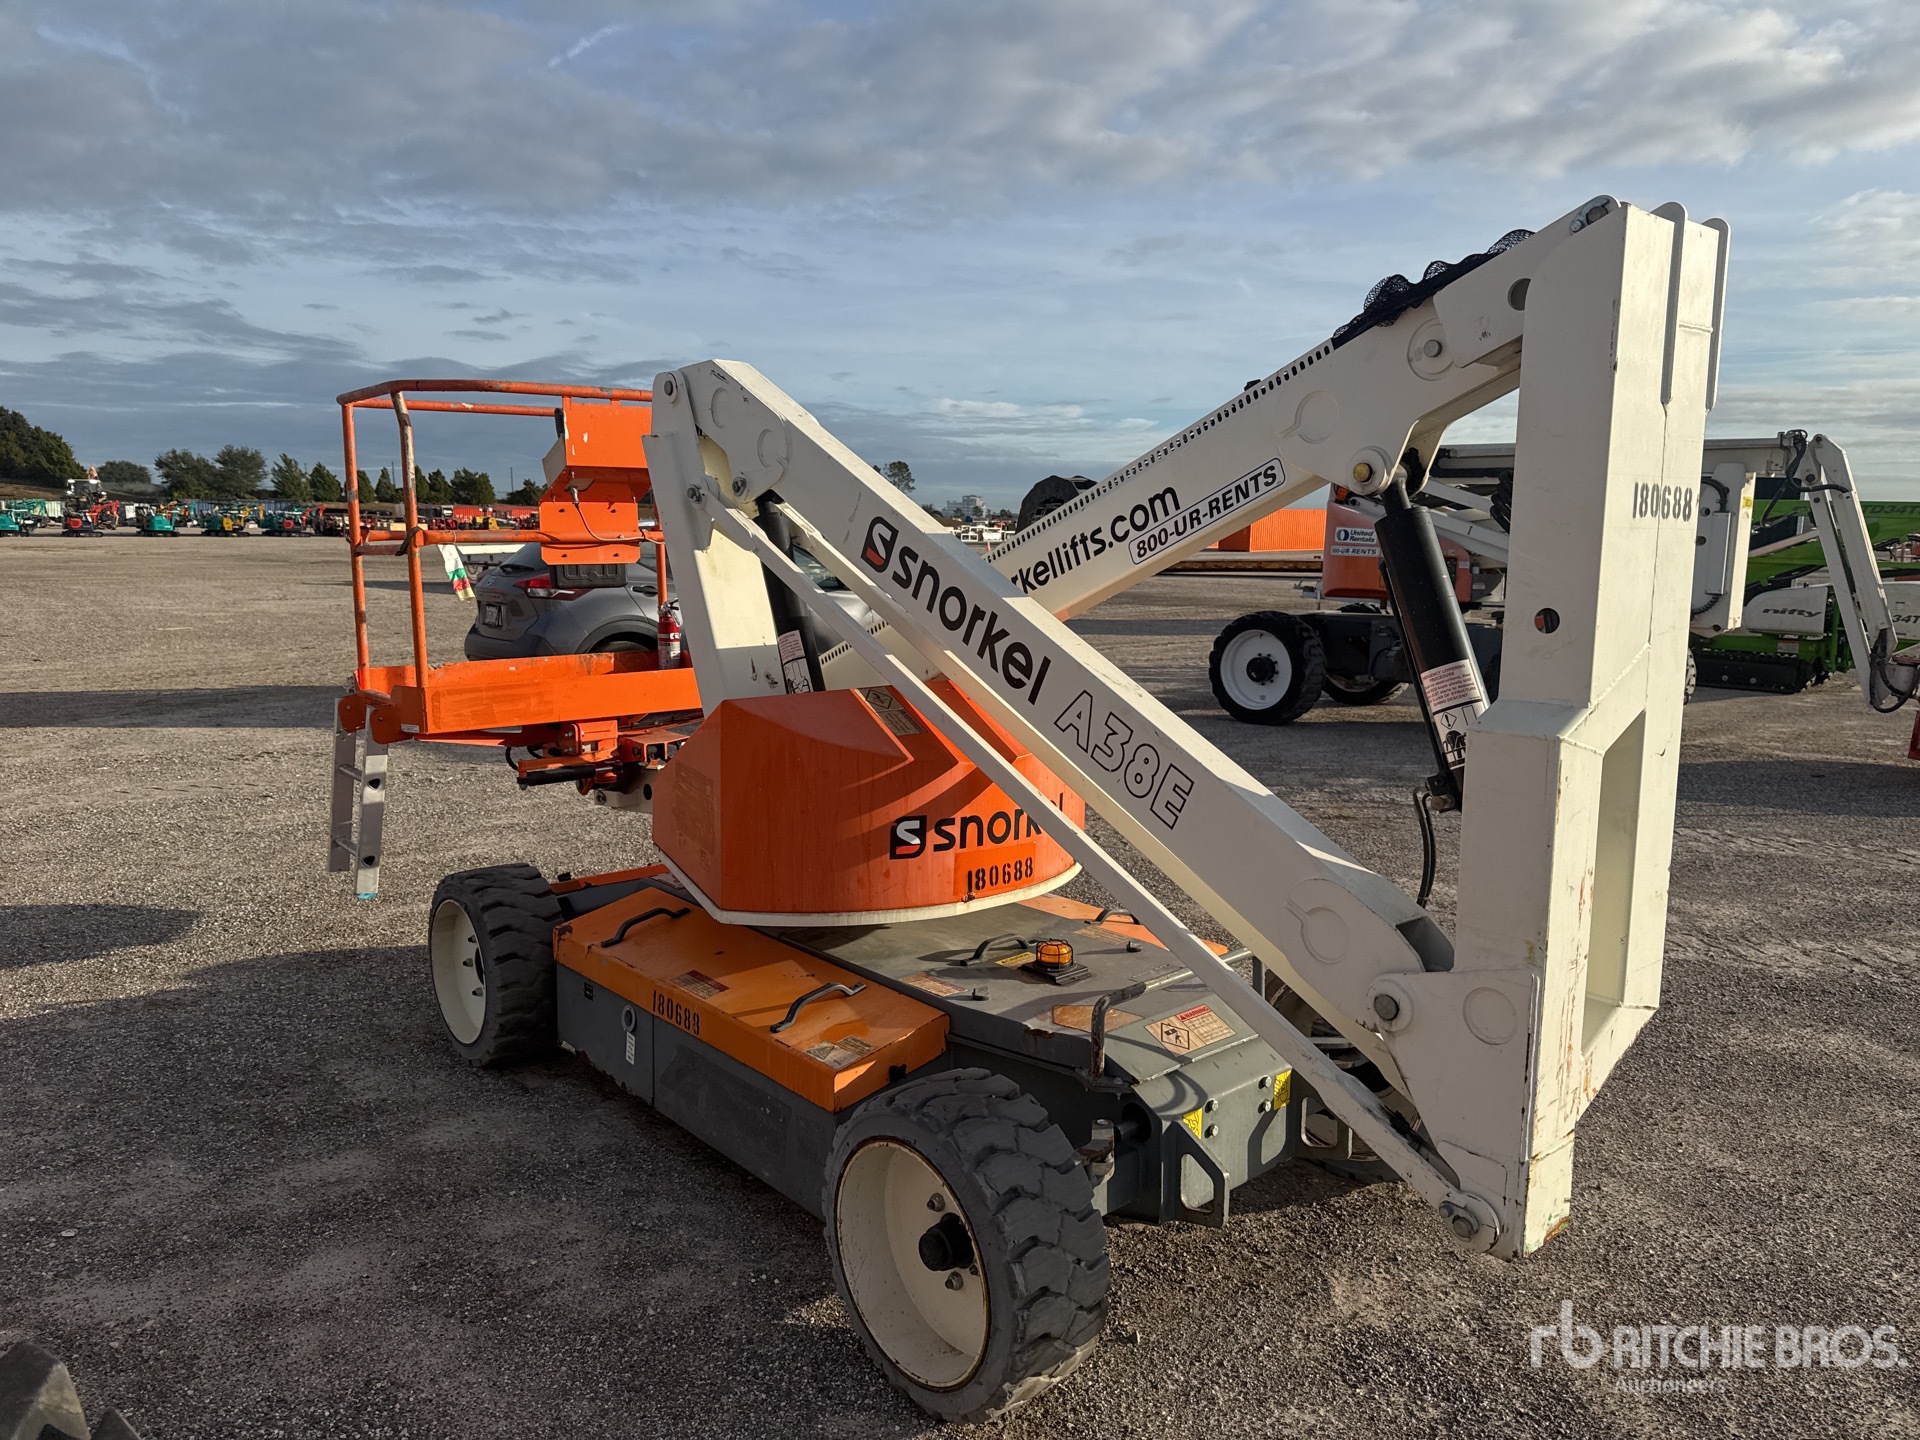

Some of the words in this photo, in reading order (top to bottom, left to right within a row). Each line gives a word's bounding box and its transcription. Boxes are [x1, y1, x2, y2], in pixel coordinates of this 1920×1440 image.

[1136, 465, 1278, 559] 800-UR-RENTS
[1632, 482, 1693, 522] 180688
[1762, 607, 1823, 618] nifty
[891, 546, 1052, 705] snorkel
[1054, 690, 1194, 830] A38E
[967, 857, 1033, 893] 180688
[653, 989, 700, 1036] 180688
